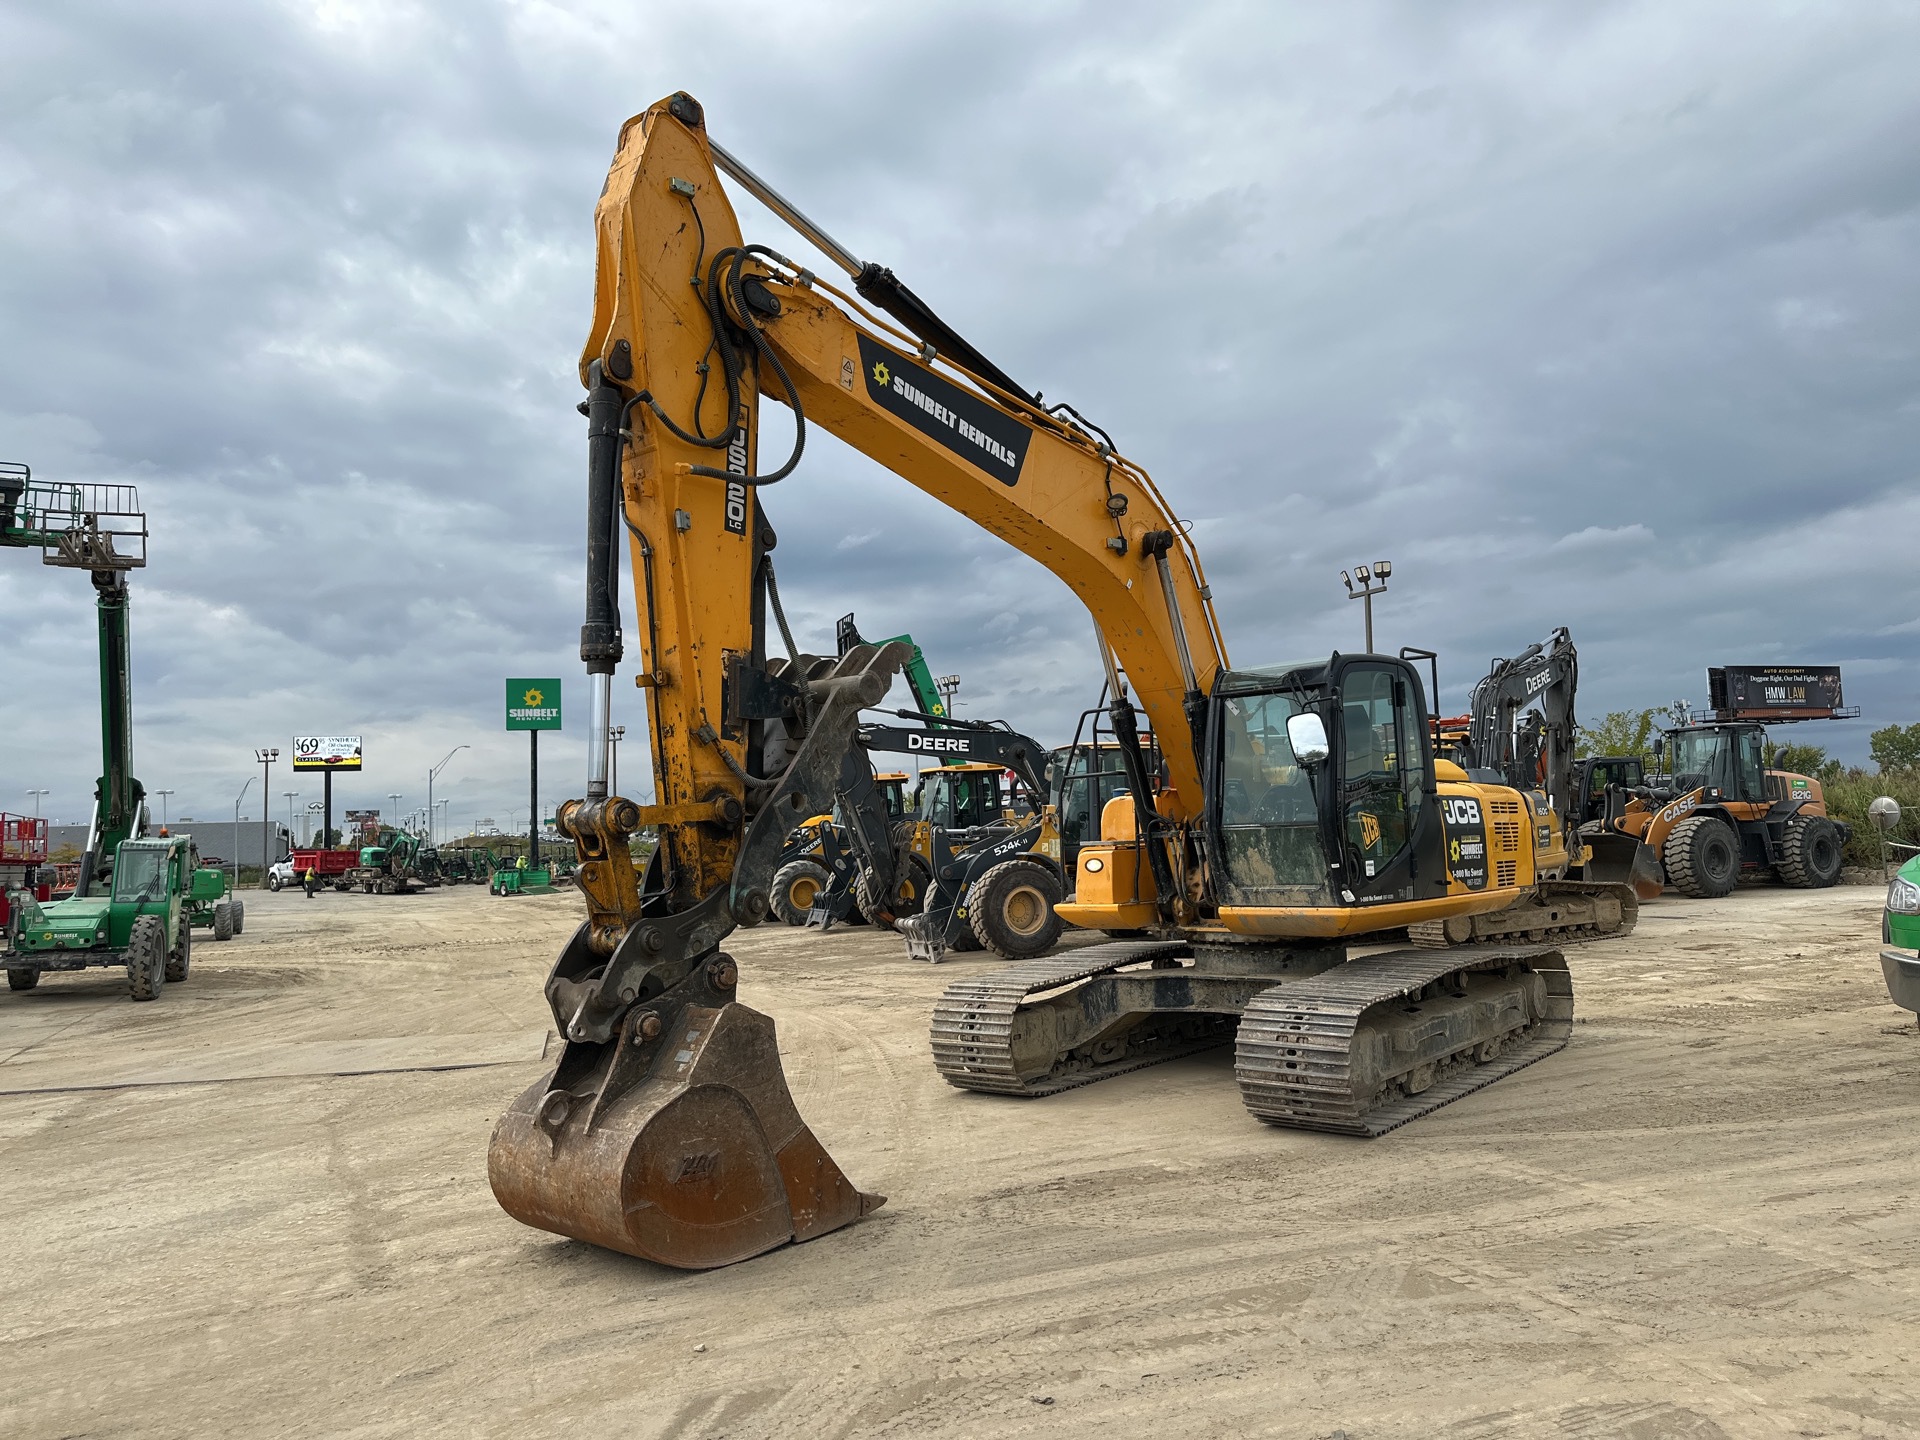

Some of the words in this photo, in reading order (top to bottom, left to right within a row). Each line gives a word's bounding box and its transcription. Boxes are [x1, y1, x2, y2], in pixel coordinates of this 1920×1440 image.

[893, 375, 957, 429] SUNBELT
[958, 418, 1016, 468] RENTALS
[1525, 668, 1551, 695] DEERE
[1764, 686, 1786, 699] HMW
[1787, 686, 1805, 699] LAW
[509, 708, 558, 717] SUNBELT
[907, 734, 970, 752] DEERE
[1791, 790, 1812, 800] 821G
[1445, 799, 1480, 825] JCB
[1663, 796, 1696, 823] CASE
[1361, 815, 1379, 847] JCB
[1460, 843, 1484, 856] SUNBELT
